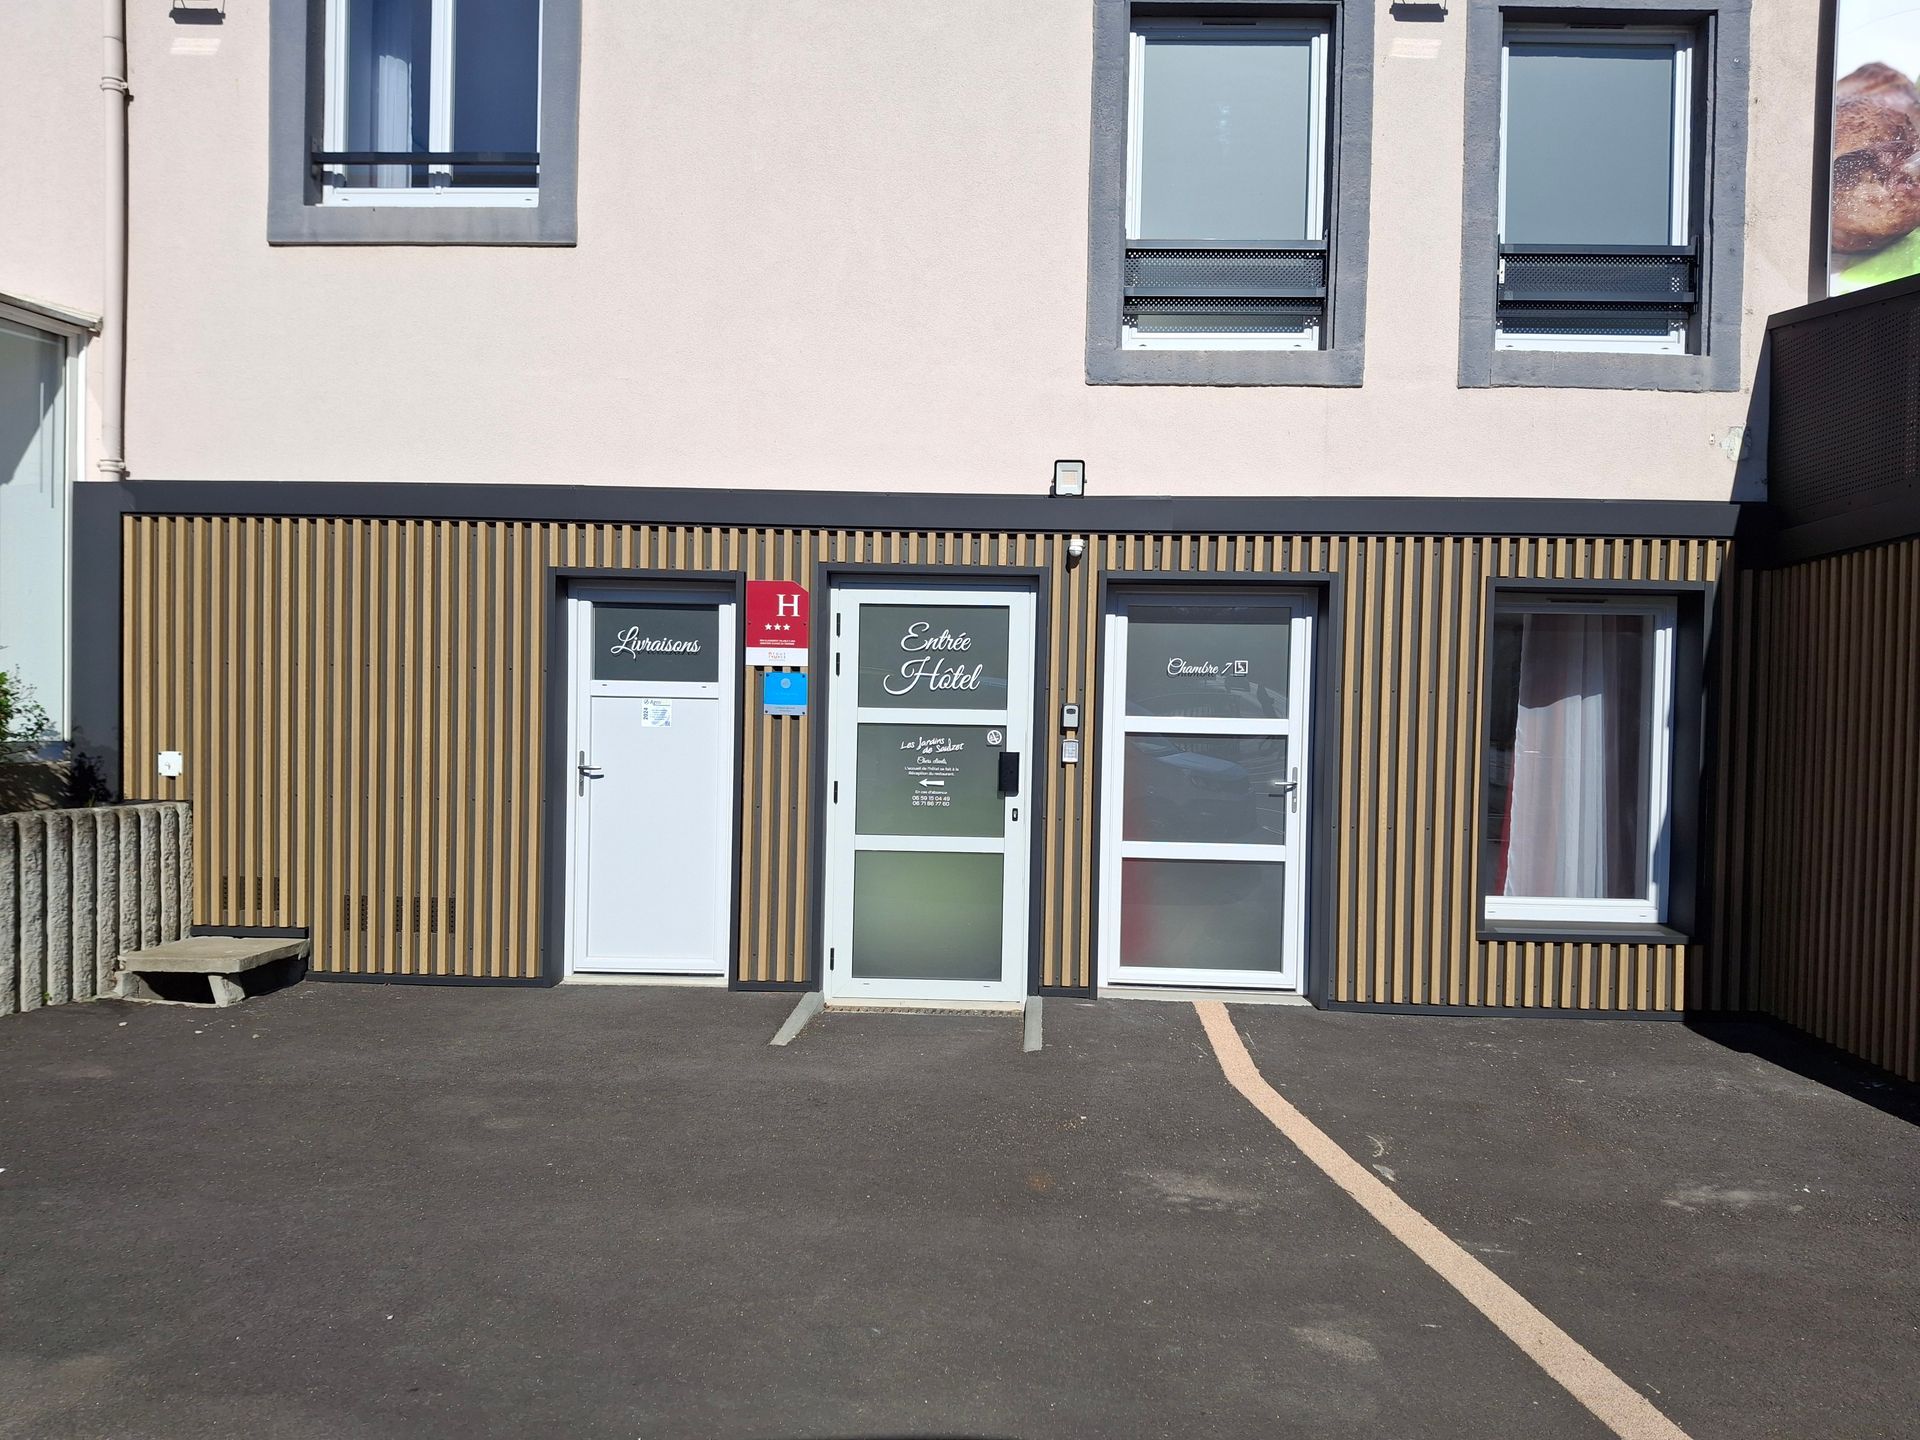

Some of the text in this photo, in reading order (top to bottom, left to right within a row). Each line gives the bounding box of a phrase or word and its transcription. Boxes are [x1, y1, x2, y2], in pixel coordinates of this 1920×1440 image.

[776, 593, 801, 617] H
[610, 625, 702, 659] Livraisons
[900, 621, 972, 651] Entrée
[883, 655, 983, 695] Hôtel
[1167, 657, 1233, 675] Chambre 7
[900, 737, 945, 750] Les Jardins
[922, 746, 933, 754] de
